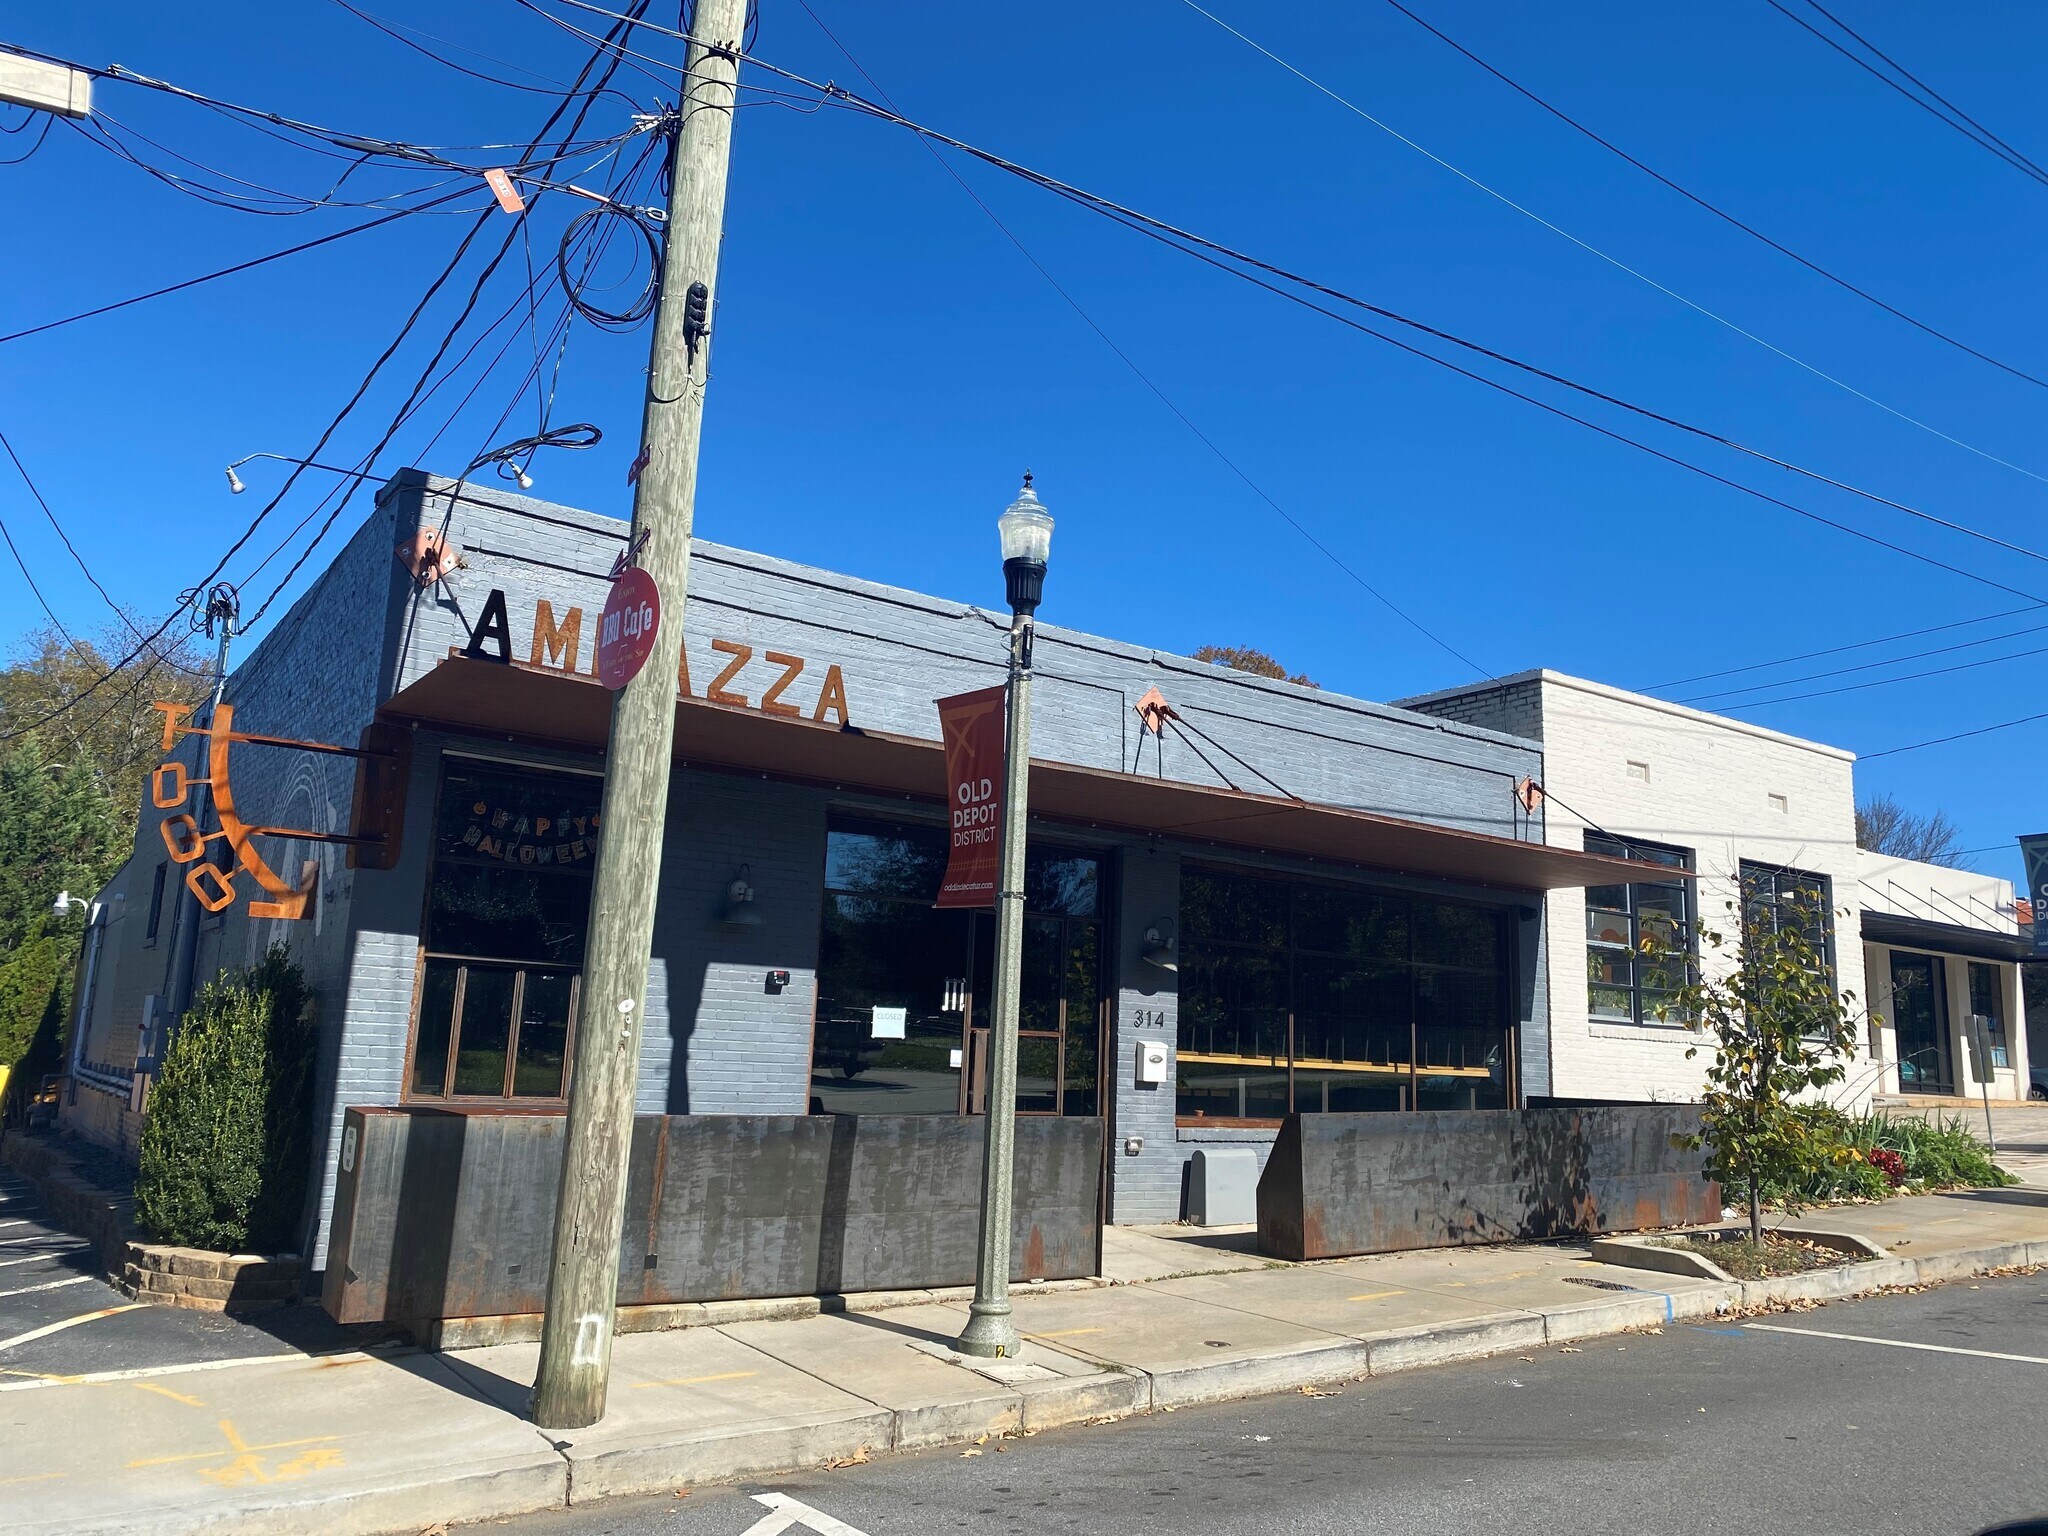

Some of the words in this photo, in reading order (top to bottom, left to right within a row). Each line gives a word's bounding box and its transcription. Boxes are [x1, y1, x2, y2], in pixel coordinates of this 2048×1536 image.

[601, 611, 620, 649] BBQ
[624, 600, 653, 641] Cafe
[466, 588, 848, 725] AMZZA
[957, 778, 992, 805] OLD
[491, 808, 587, 837] HAPPY
[953, 803, 997, 828] DEPOT
[954, 826, 996, 847] DISTRICT
[876, 1012, 903, 1021] CLOSED
[1133, 1009, 1164, 1029] 314
[997, 1345, 1004, 1359] 2
